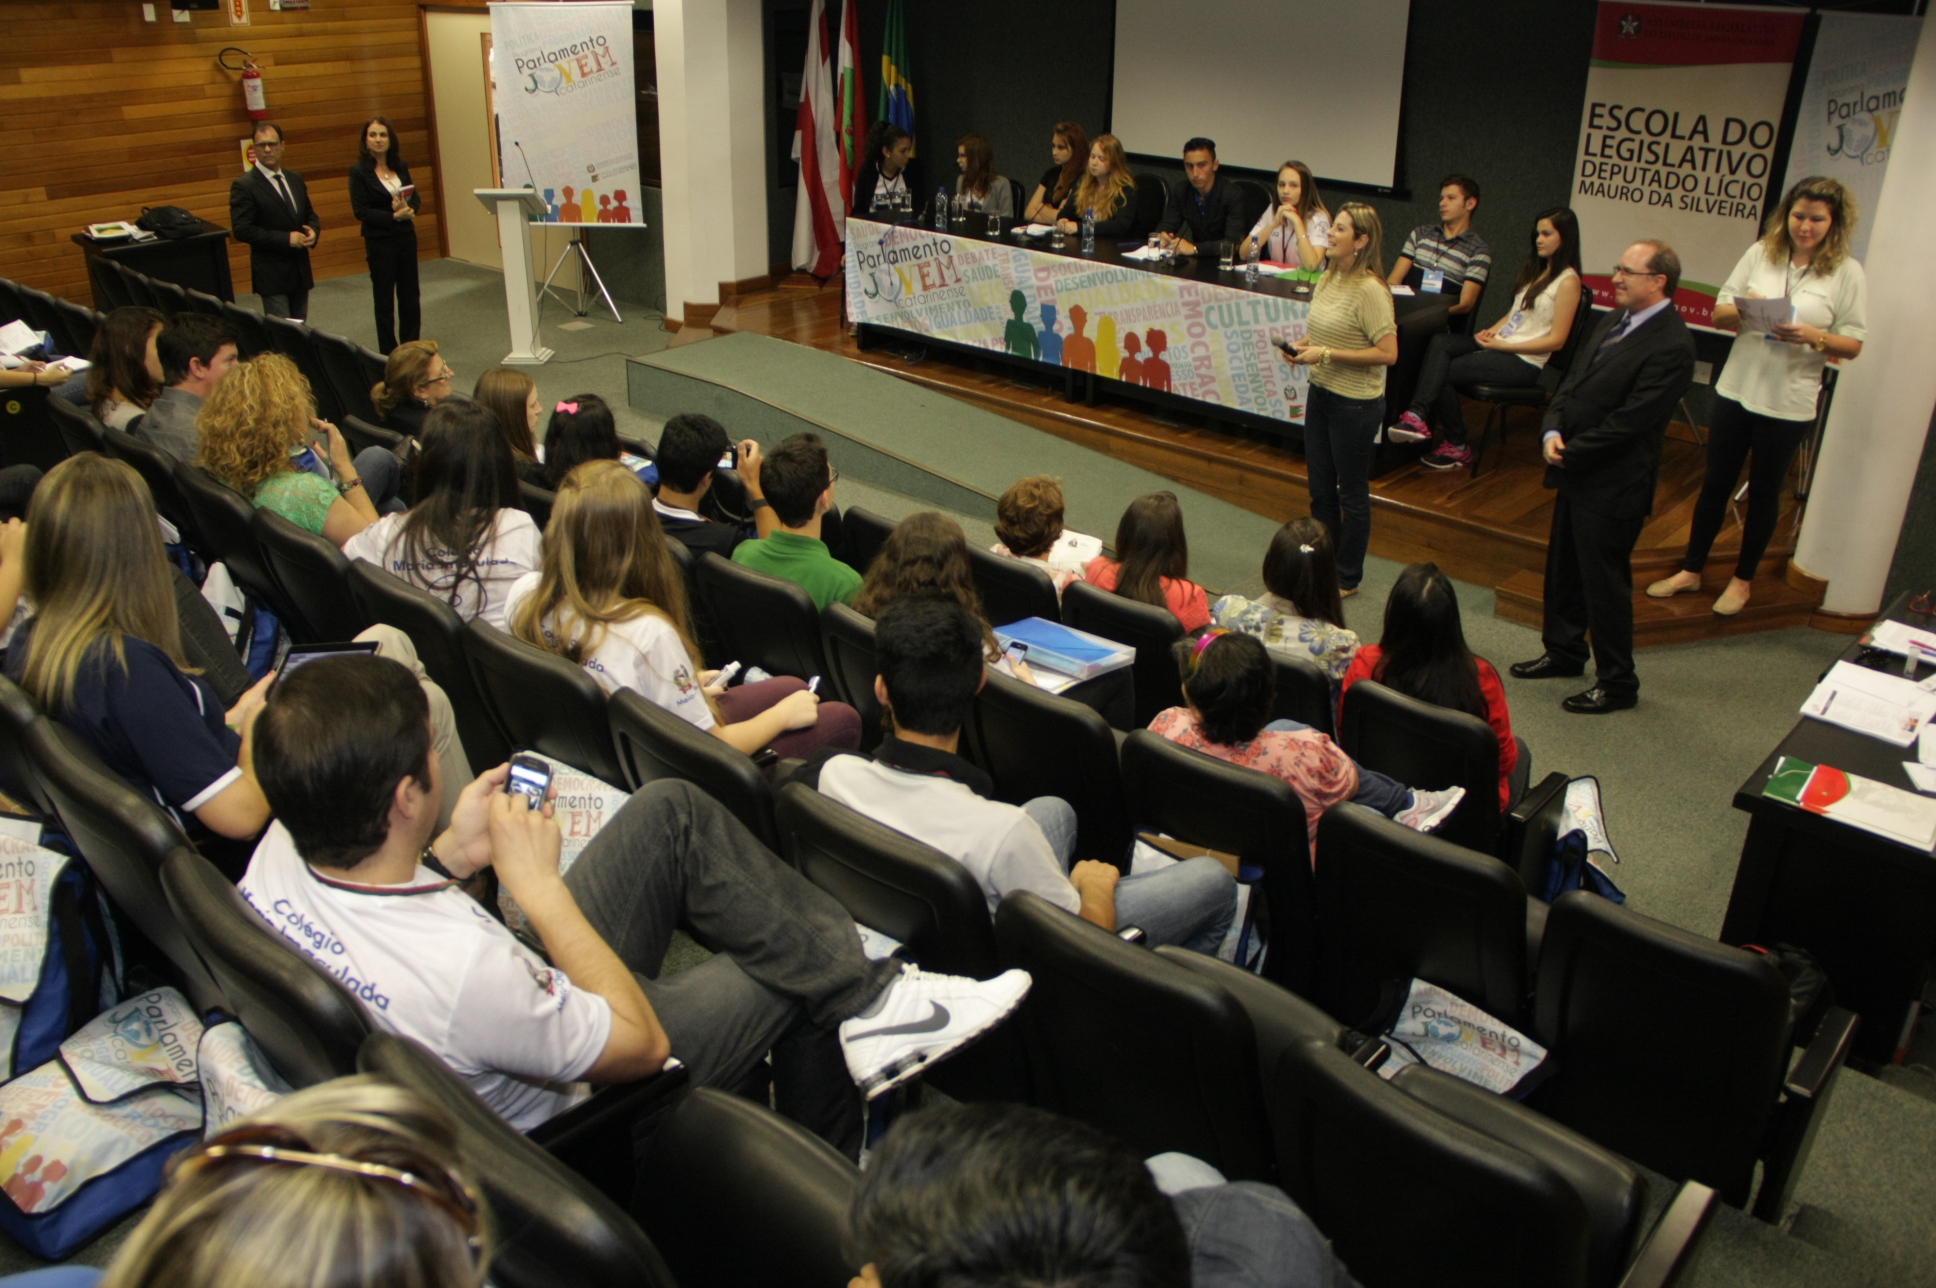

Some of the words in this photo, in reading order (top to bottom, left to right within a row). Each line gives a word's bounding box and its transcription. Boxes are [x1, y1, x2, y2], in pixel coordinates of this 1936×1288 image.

[514, 35, 607, 75] Parlamento
[524, 46, 618, 96] JOVEM
[559, 67, 621, 96] catarinense
[1588, 102, 1710, 144] ESCOLA
[1721, 117, 1775, 150] DO
[1826, 109, 1900, 159] JOV
[1584, 133, 1769, 179] LEGISLATIVO
[1578, 180, 1643, 204] MAURO
[1648, 190, 1673, 208] DA
[1679, 194, 1758, 221] SILVEIRA
[1581, 160, 1698, 193] DEPUTADO
[1704, 174, 1763, 202] LÍCIO
[857, 238, 951, 270] Parlamento
[957, 247, 998, 266] DEBATE
[963, 260, 1001, 284] SAÚDE
[864, 256, 962, 301] JOVEM
[899, 285, 966, 309] catarinense
[968, 281, 1008, 308] LEIS
[929, 306, 996, 331] IGUALDADE
[1240, 328, 1268, 413] DESENVOL
[554, 793, 604, 810] mento
[273, 899, 346, 955] Colégio
[1411, 1004, 1521, 1048] Parlamento
